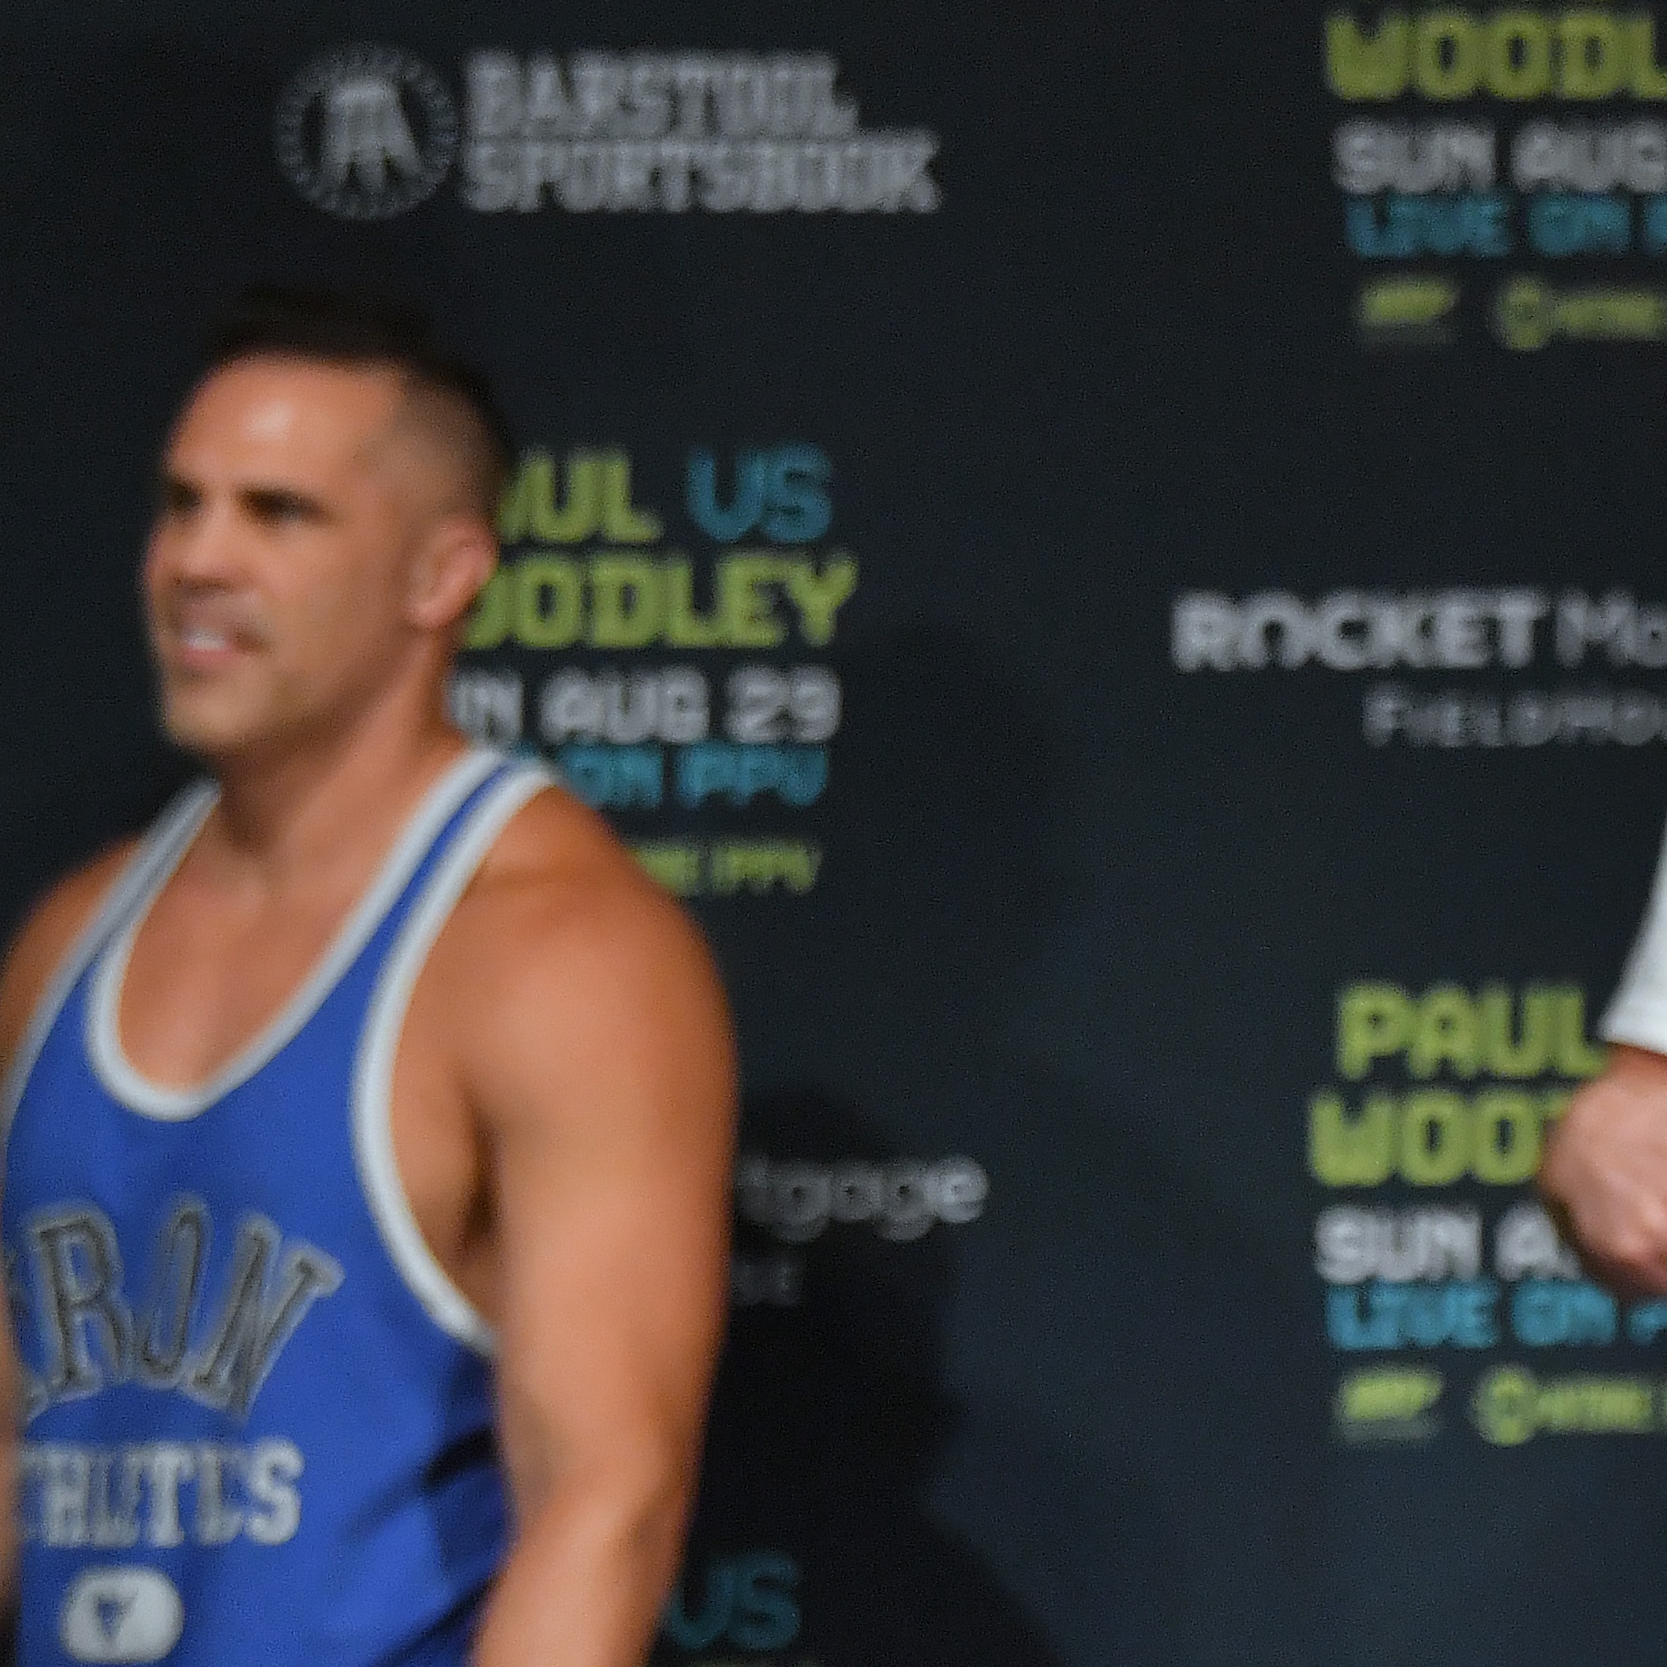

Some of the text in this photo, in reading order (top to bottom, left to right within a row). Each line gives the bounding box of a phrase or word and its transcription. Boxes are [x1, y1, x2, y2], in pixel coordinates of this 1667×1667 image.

[464, 49, 861, 133] BARSTOOL
[462, 132, 943, 214] SPORTSBOOK
[1331, 118, 1498, 195] SUN
[1170, 586, 1548, 672] ROCKET
[539, 665, 710, 745] AUG
[723, 664, 842, 745] 29
[1336, 983, 1610, 1080] PAUL
[1315, 1203, 1483, 1284] SUN
